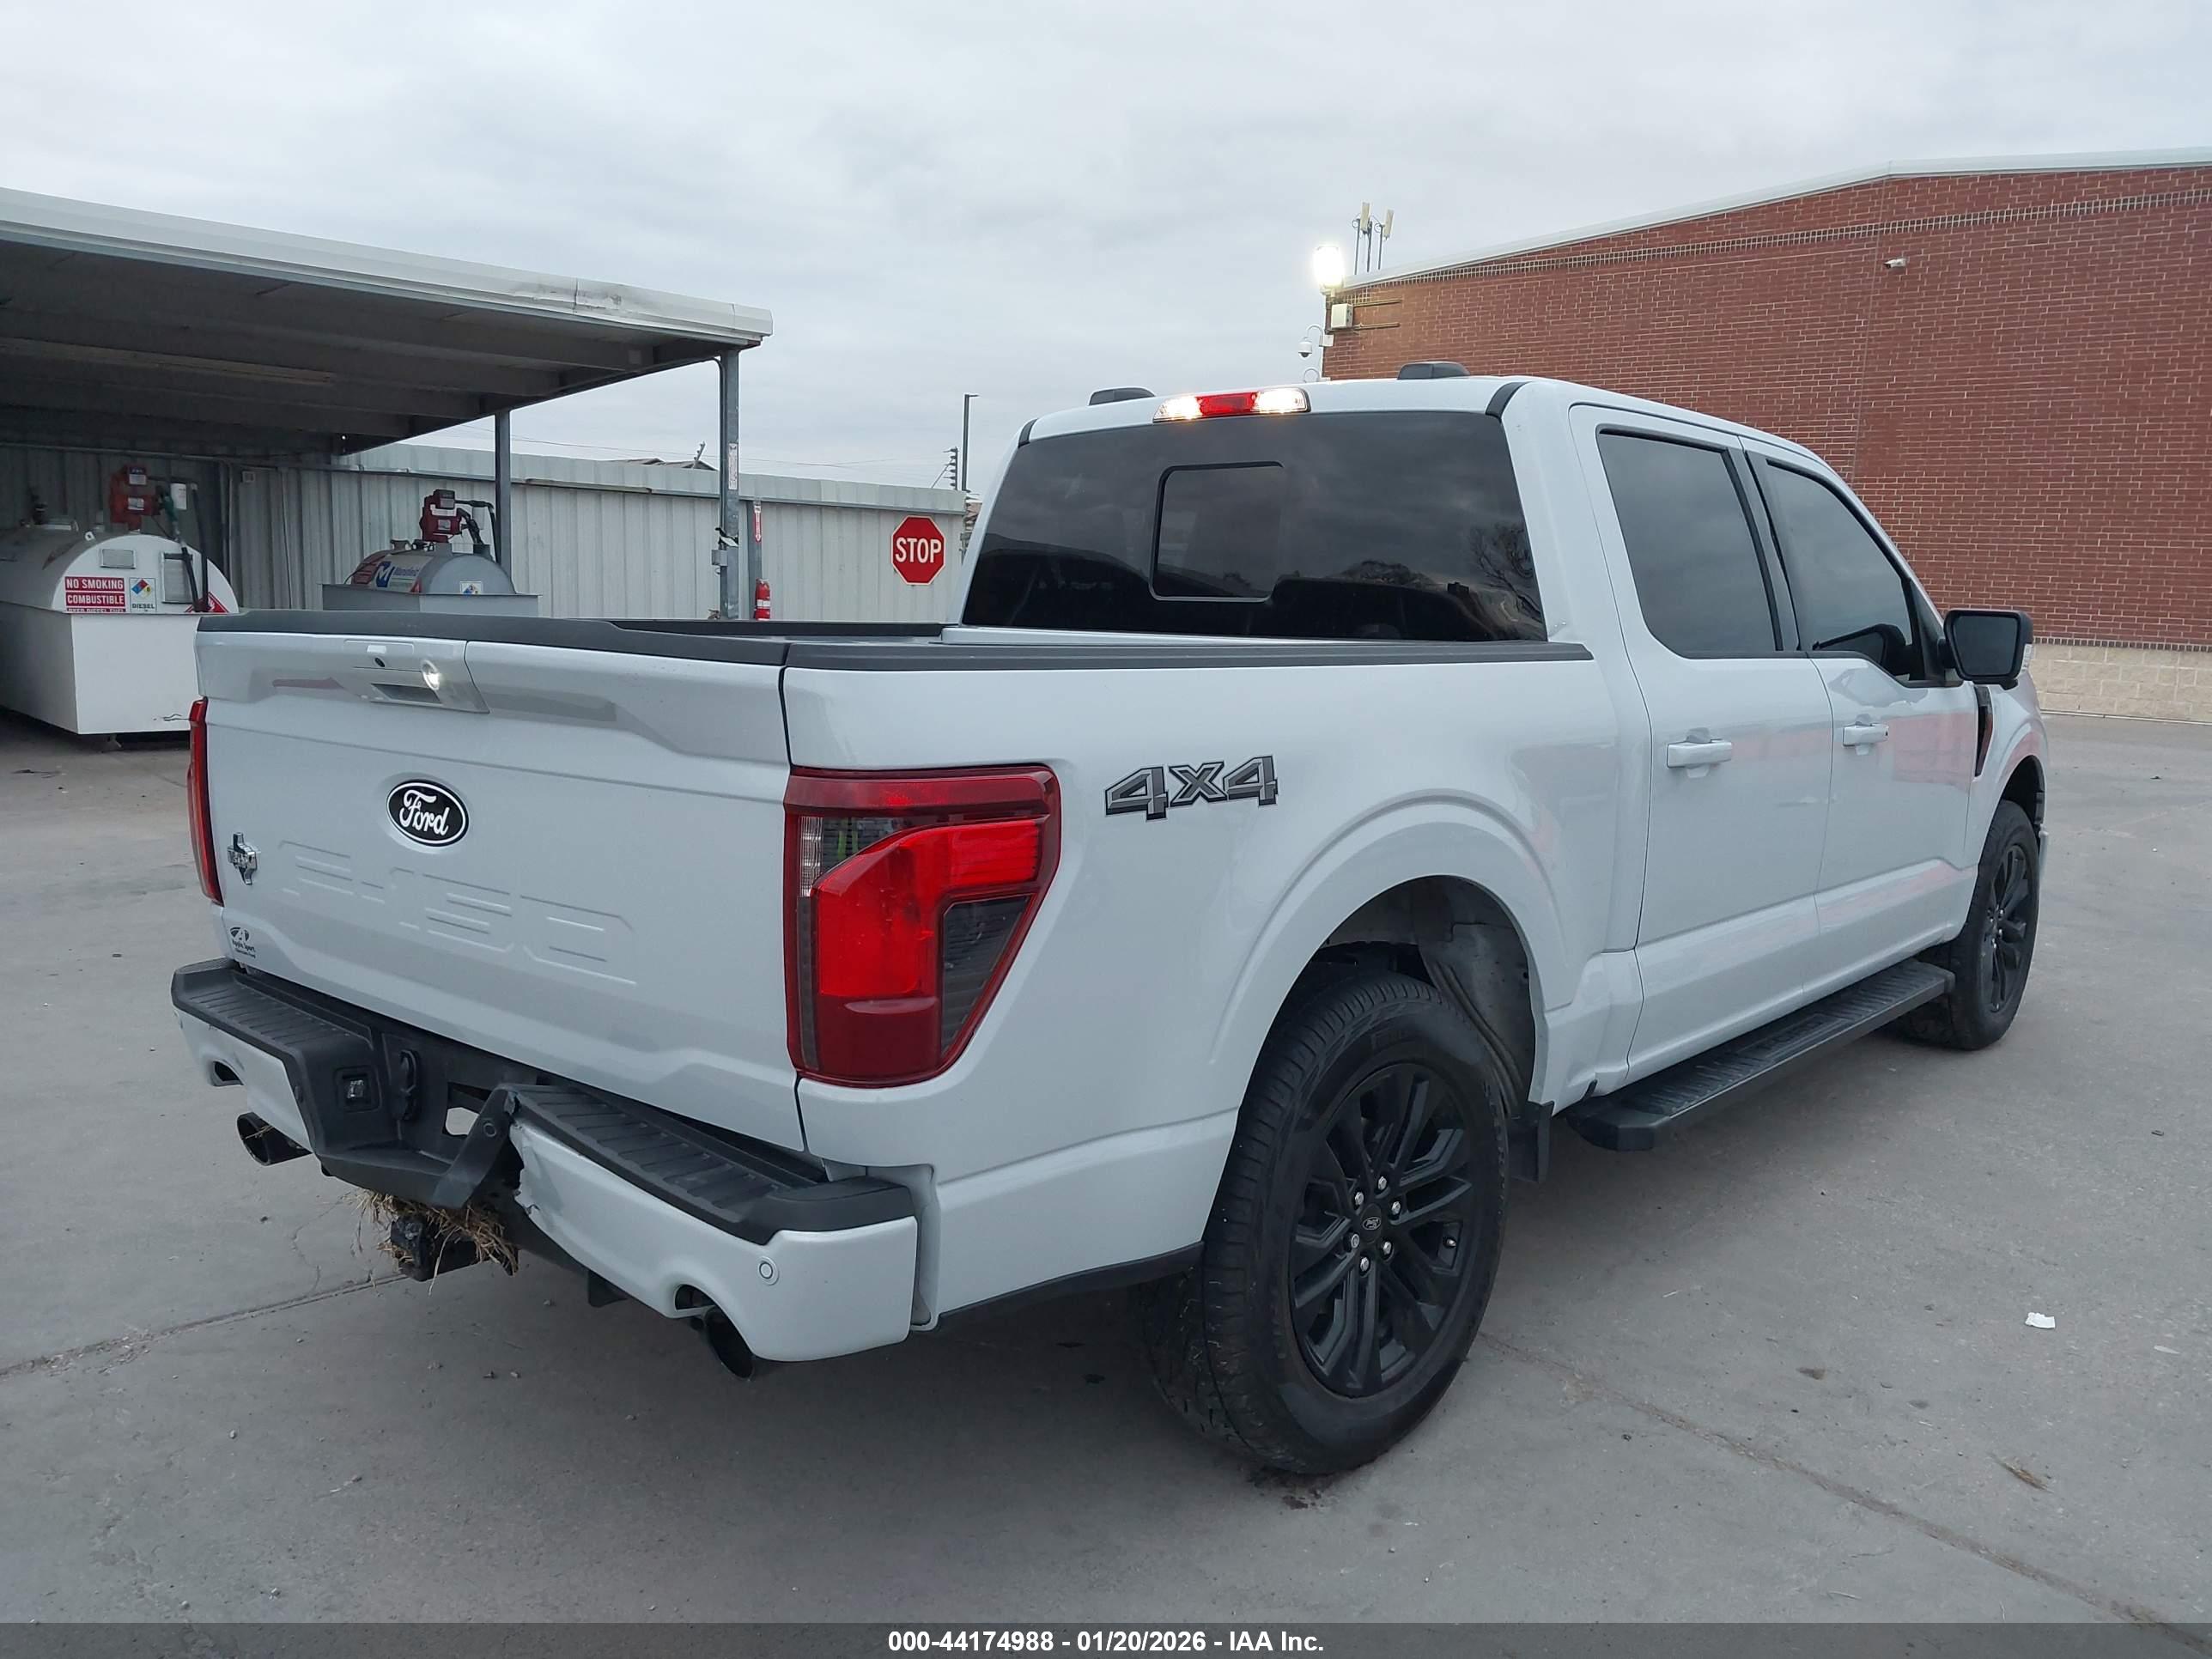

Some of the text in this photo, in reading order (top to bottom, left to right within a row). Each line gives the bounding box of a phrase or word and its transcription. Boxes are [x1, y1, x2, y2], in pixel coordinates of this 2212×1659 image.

[895, 537, 942, 563] STOP
[66, 578, 124, 590] NO SMOKING
[67, 595, 125, 605] COMBUSTIBLE
[399, 789, 450, 836] Ford
